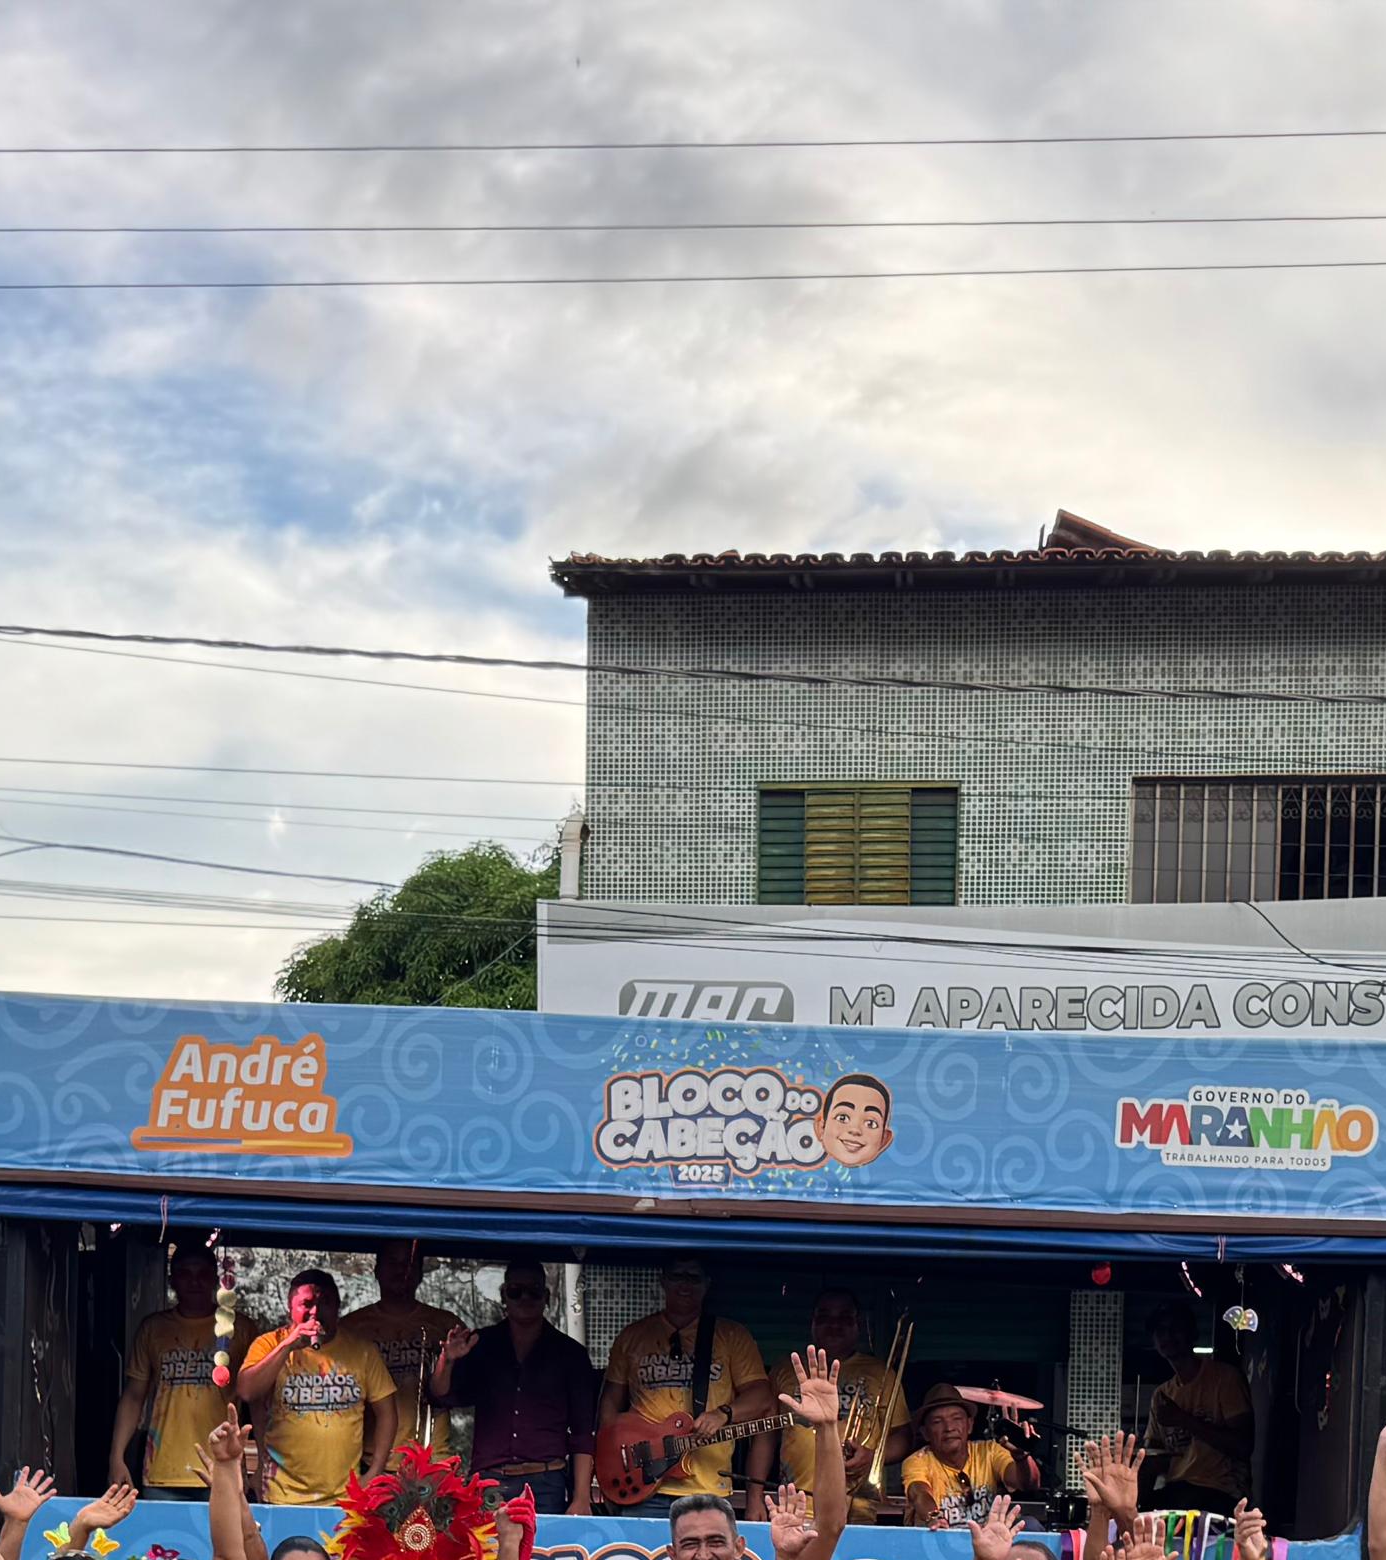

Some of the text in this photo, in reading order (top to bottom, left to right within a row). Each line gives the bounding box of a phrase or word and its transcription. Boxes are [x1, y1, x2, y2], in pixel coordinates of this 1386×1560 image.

[907, 984, 1221, 1031] APARECIDA
[170, 1042, 319, 1087] André
[157, 1088, 329, 1133] Fufuca
[610, 1072, 819, 1121] BLOCO DO
[1193, 1090, 1305, 1105] GOVERNO DO
[600, 1109, 825, 1170] CABEÇÃO
[1120, 1103, 1374, 1152] MARANHÃO
[676, 1163, 725, 1183] 2025
[1165, 1152, 1327, 1167] TRABALHANDO PARA TODOS
[282, 1386, 362, 1405] RIBEIRAS
